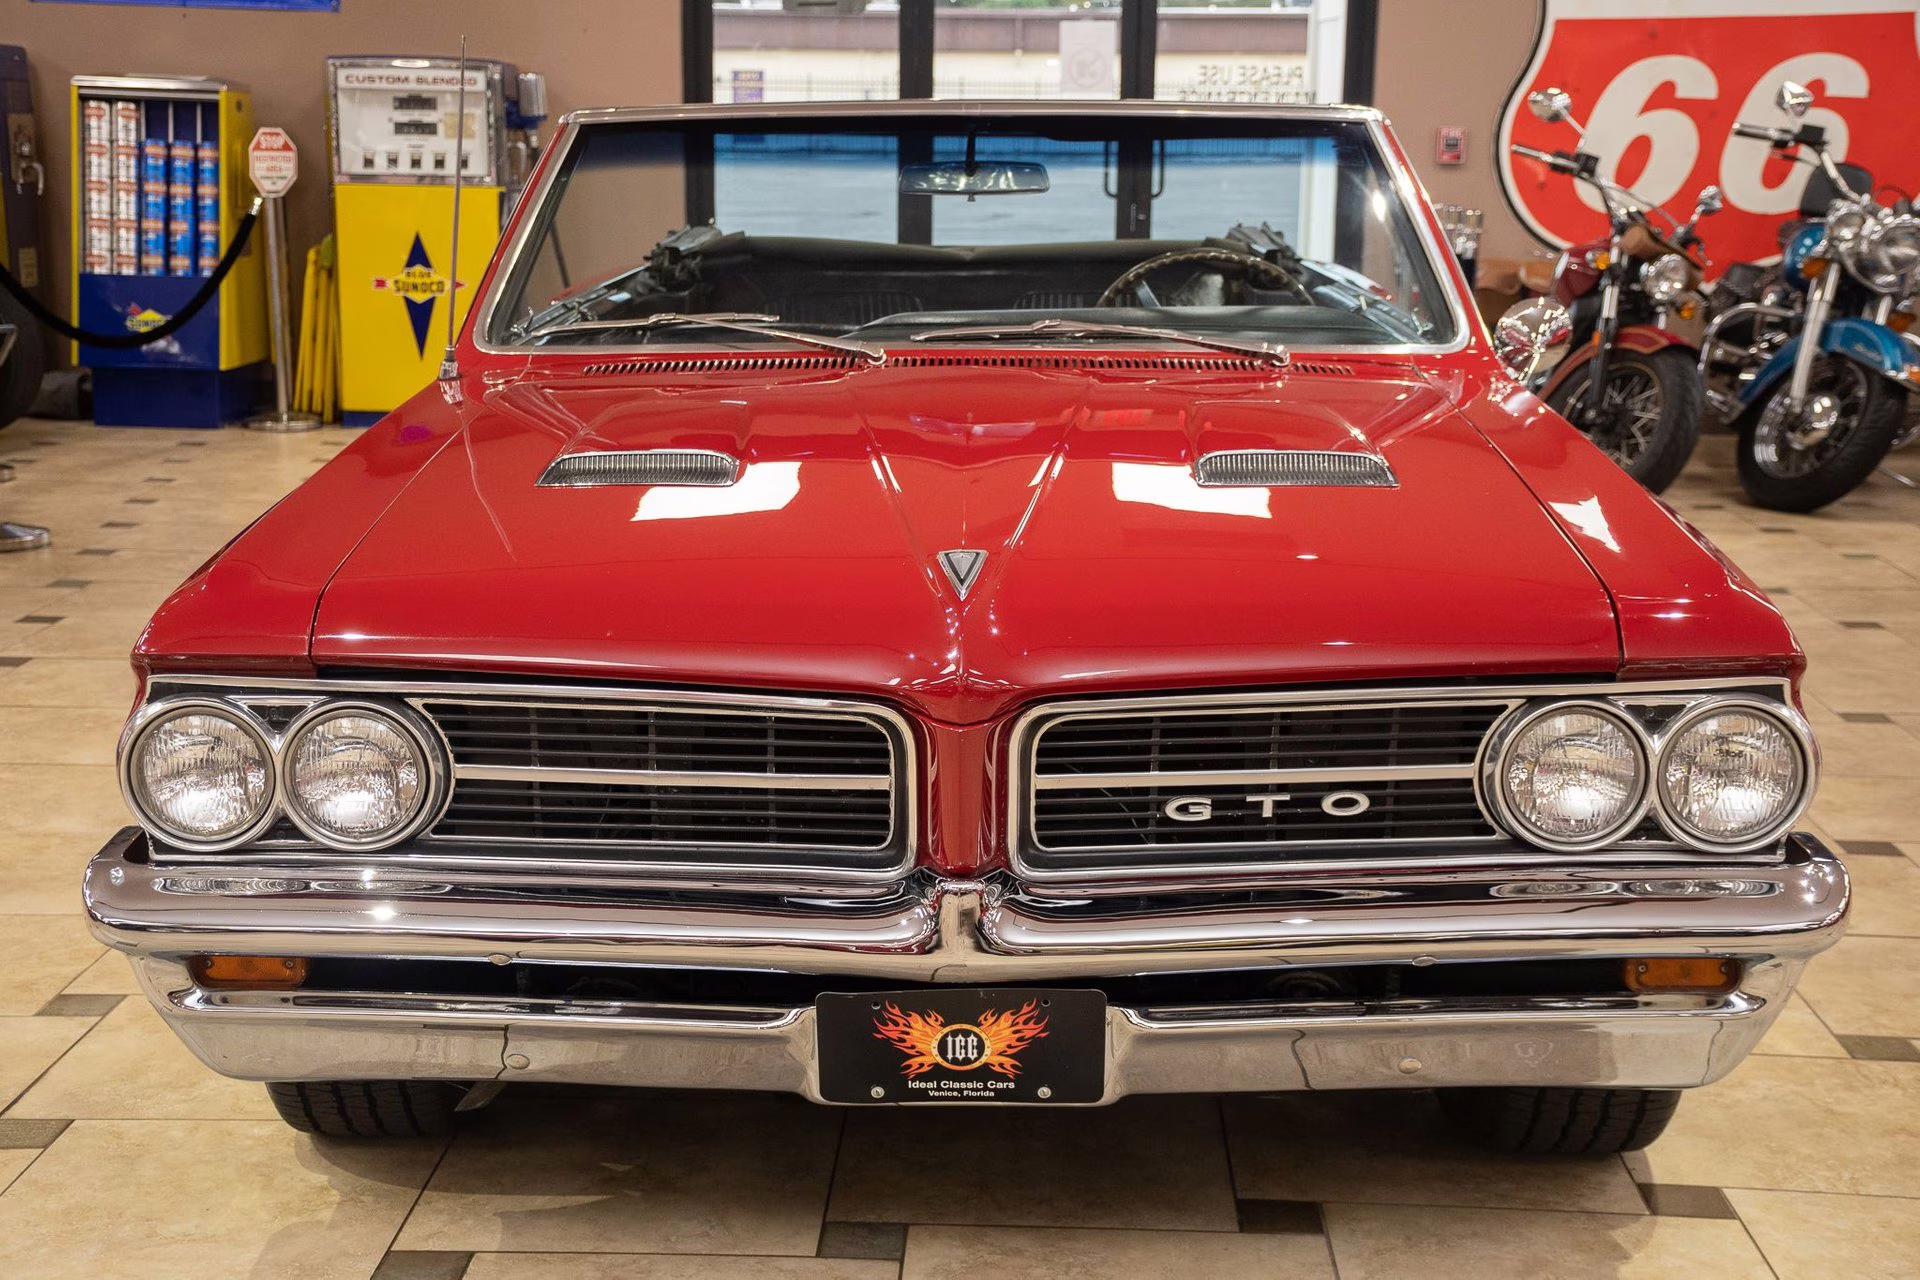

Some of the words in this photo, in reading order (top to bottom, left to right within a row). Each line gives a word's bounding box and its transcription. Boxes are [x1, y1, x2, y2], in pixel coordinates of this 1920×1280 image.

[345, 74, 409, 85] CUSTOM
[1573, 53, 1869, 214] 66
[260, 134, 284, 149] STOP
[394, 280, 445, 293] SUNOCO
[1164, 791, 1370, 821] GTO
[908, 1080, 937, 1089] Ideal
[940, 1080, 984, 1089] Classic
[987, 1080, 1015, 1089] Cars
